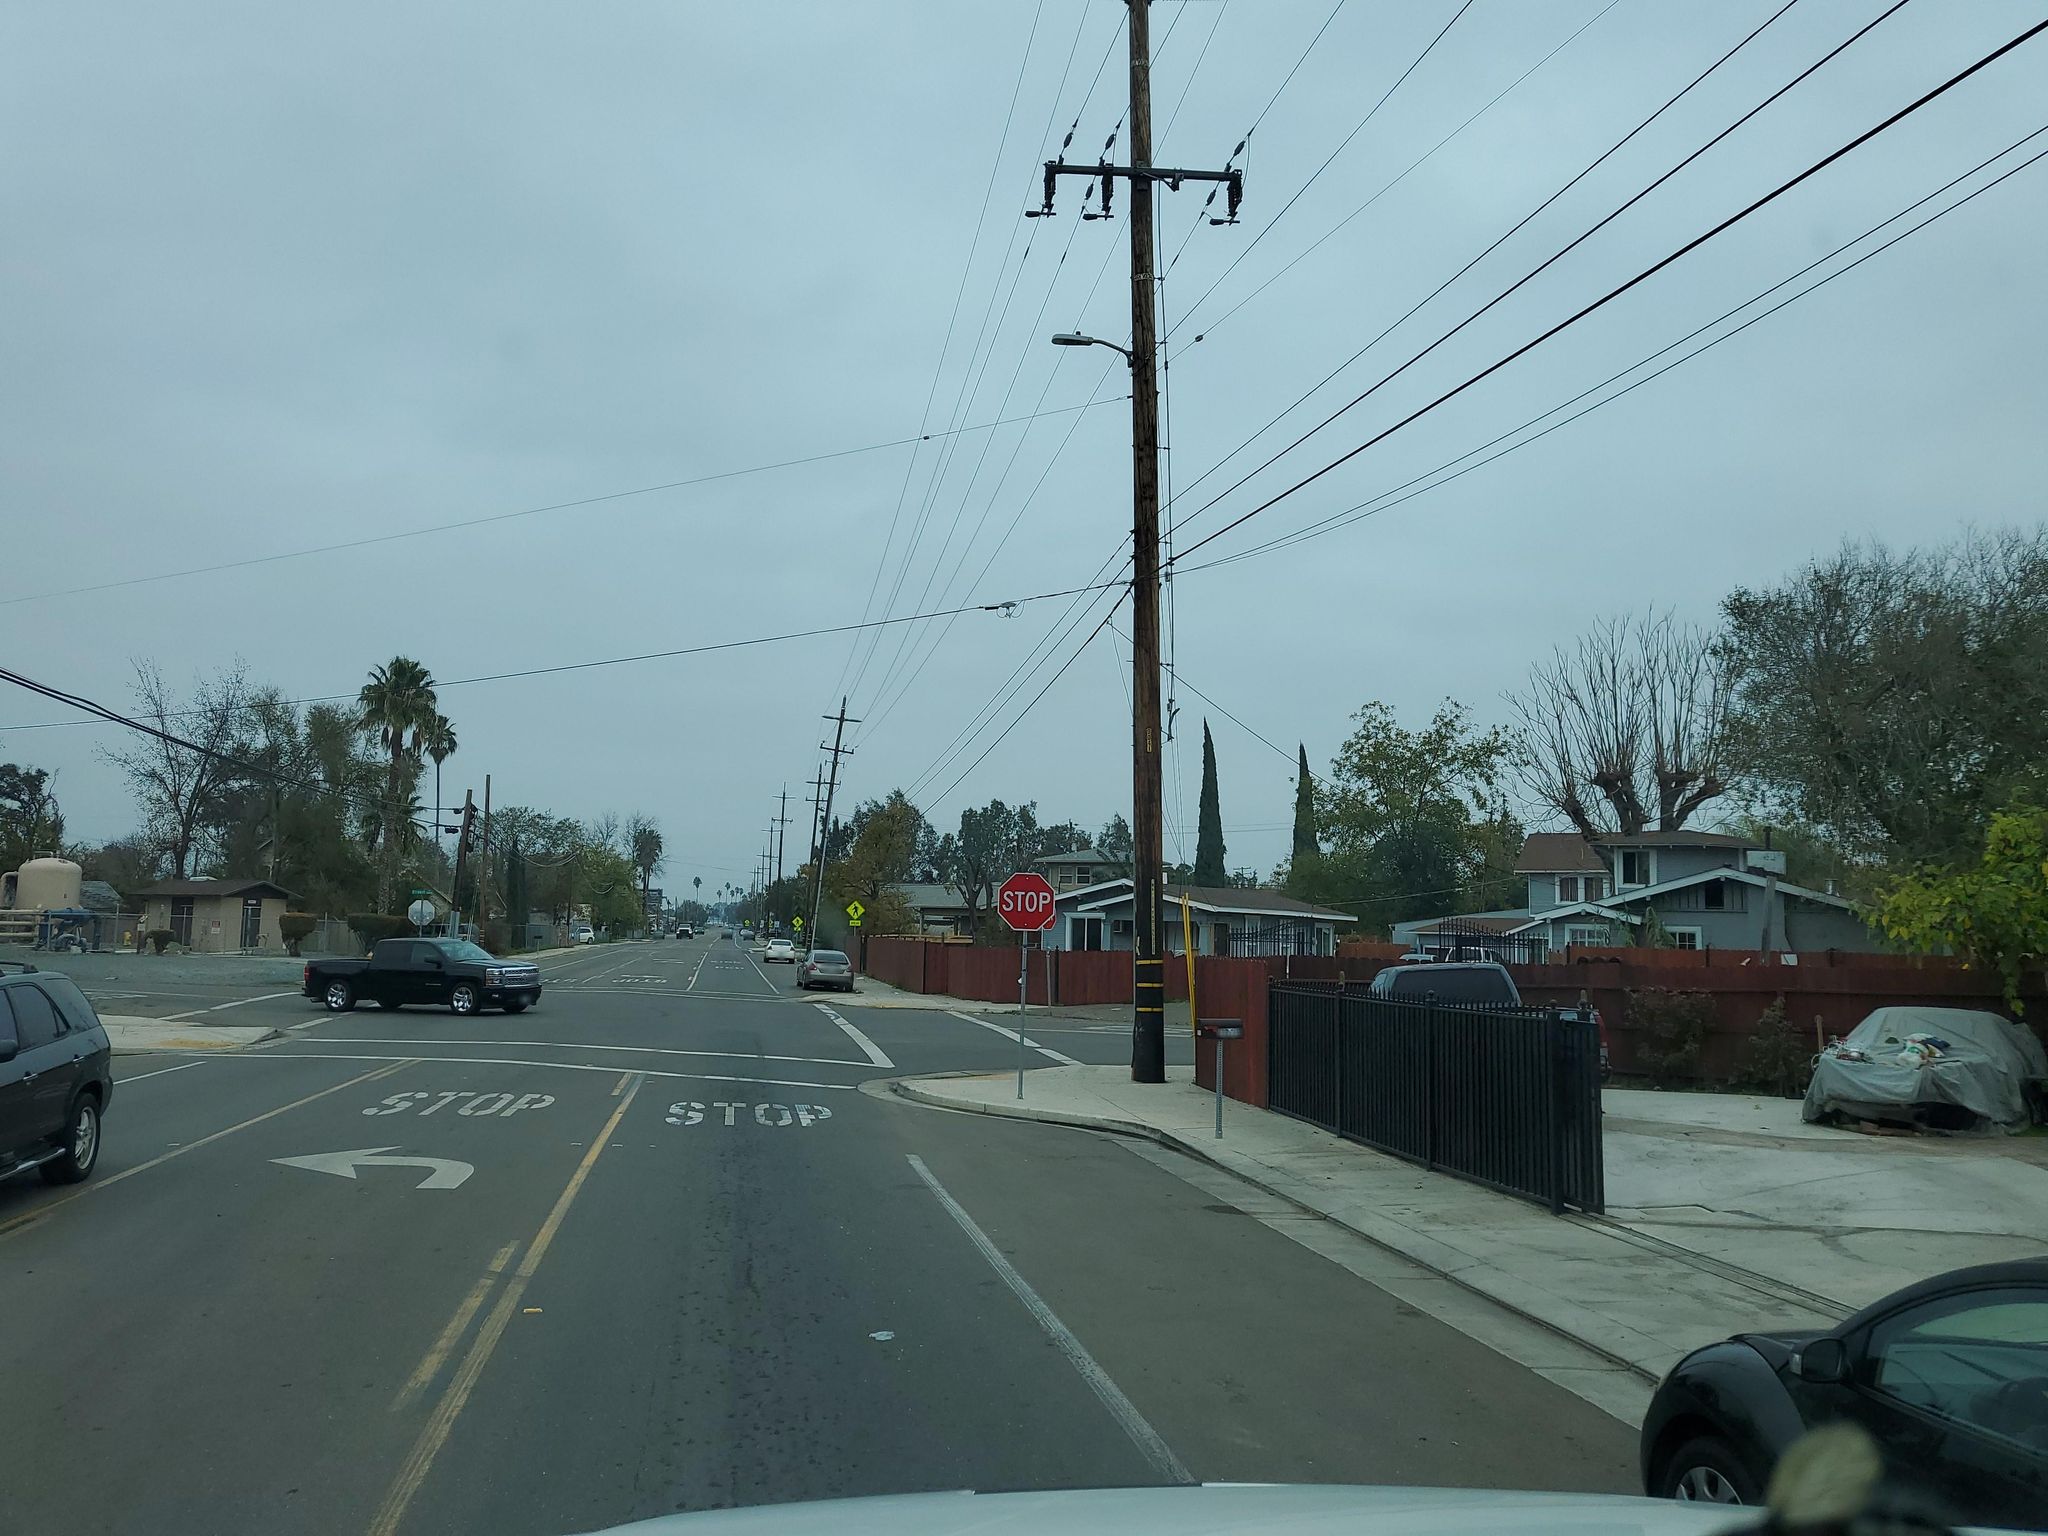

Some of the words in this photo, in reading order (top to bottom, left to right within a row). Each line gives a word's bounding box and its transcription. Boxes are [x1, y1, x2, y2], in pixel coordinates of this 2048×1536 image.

[1002, 890, 1051, 913] STOP
[361, 1091, 556, 1117] STOP
[664, 1101, 833, 1127] STOP
